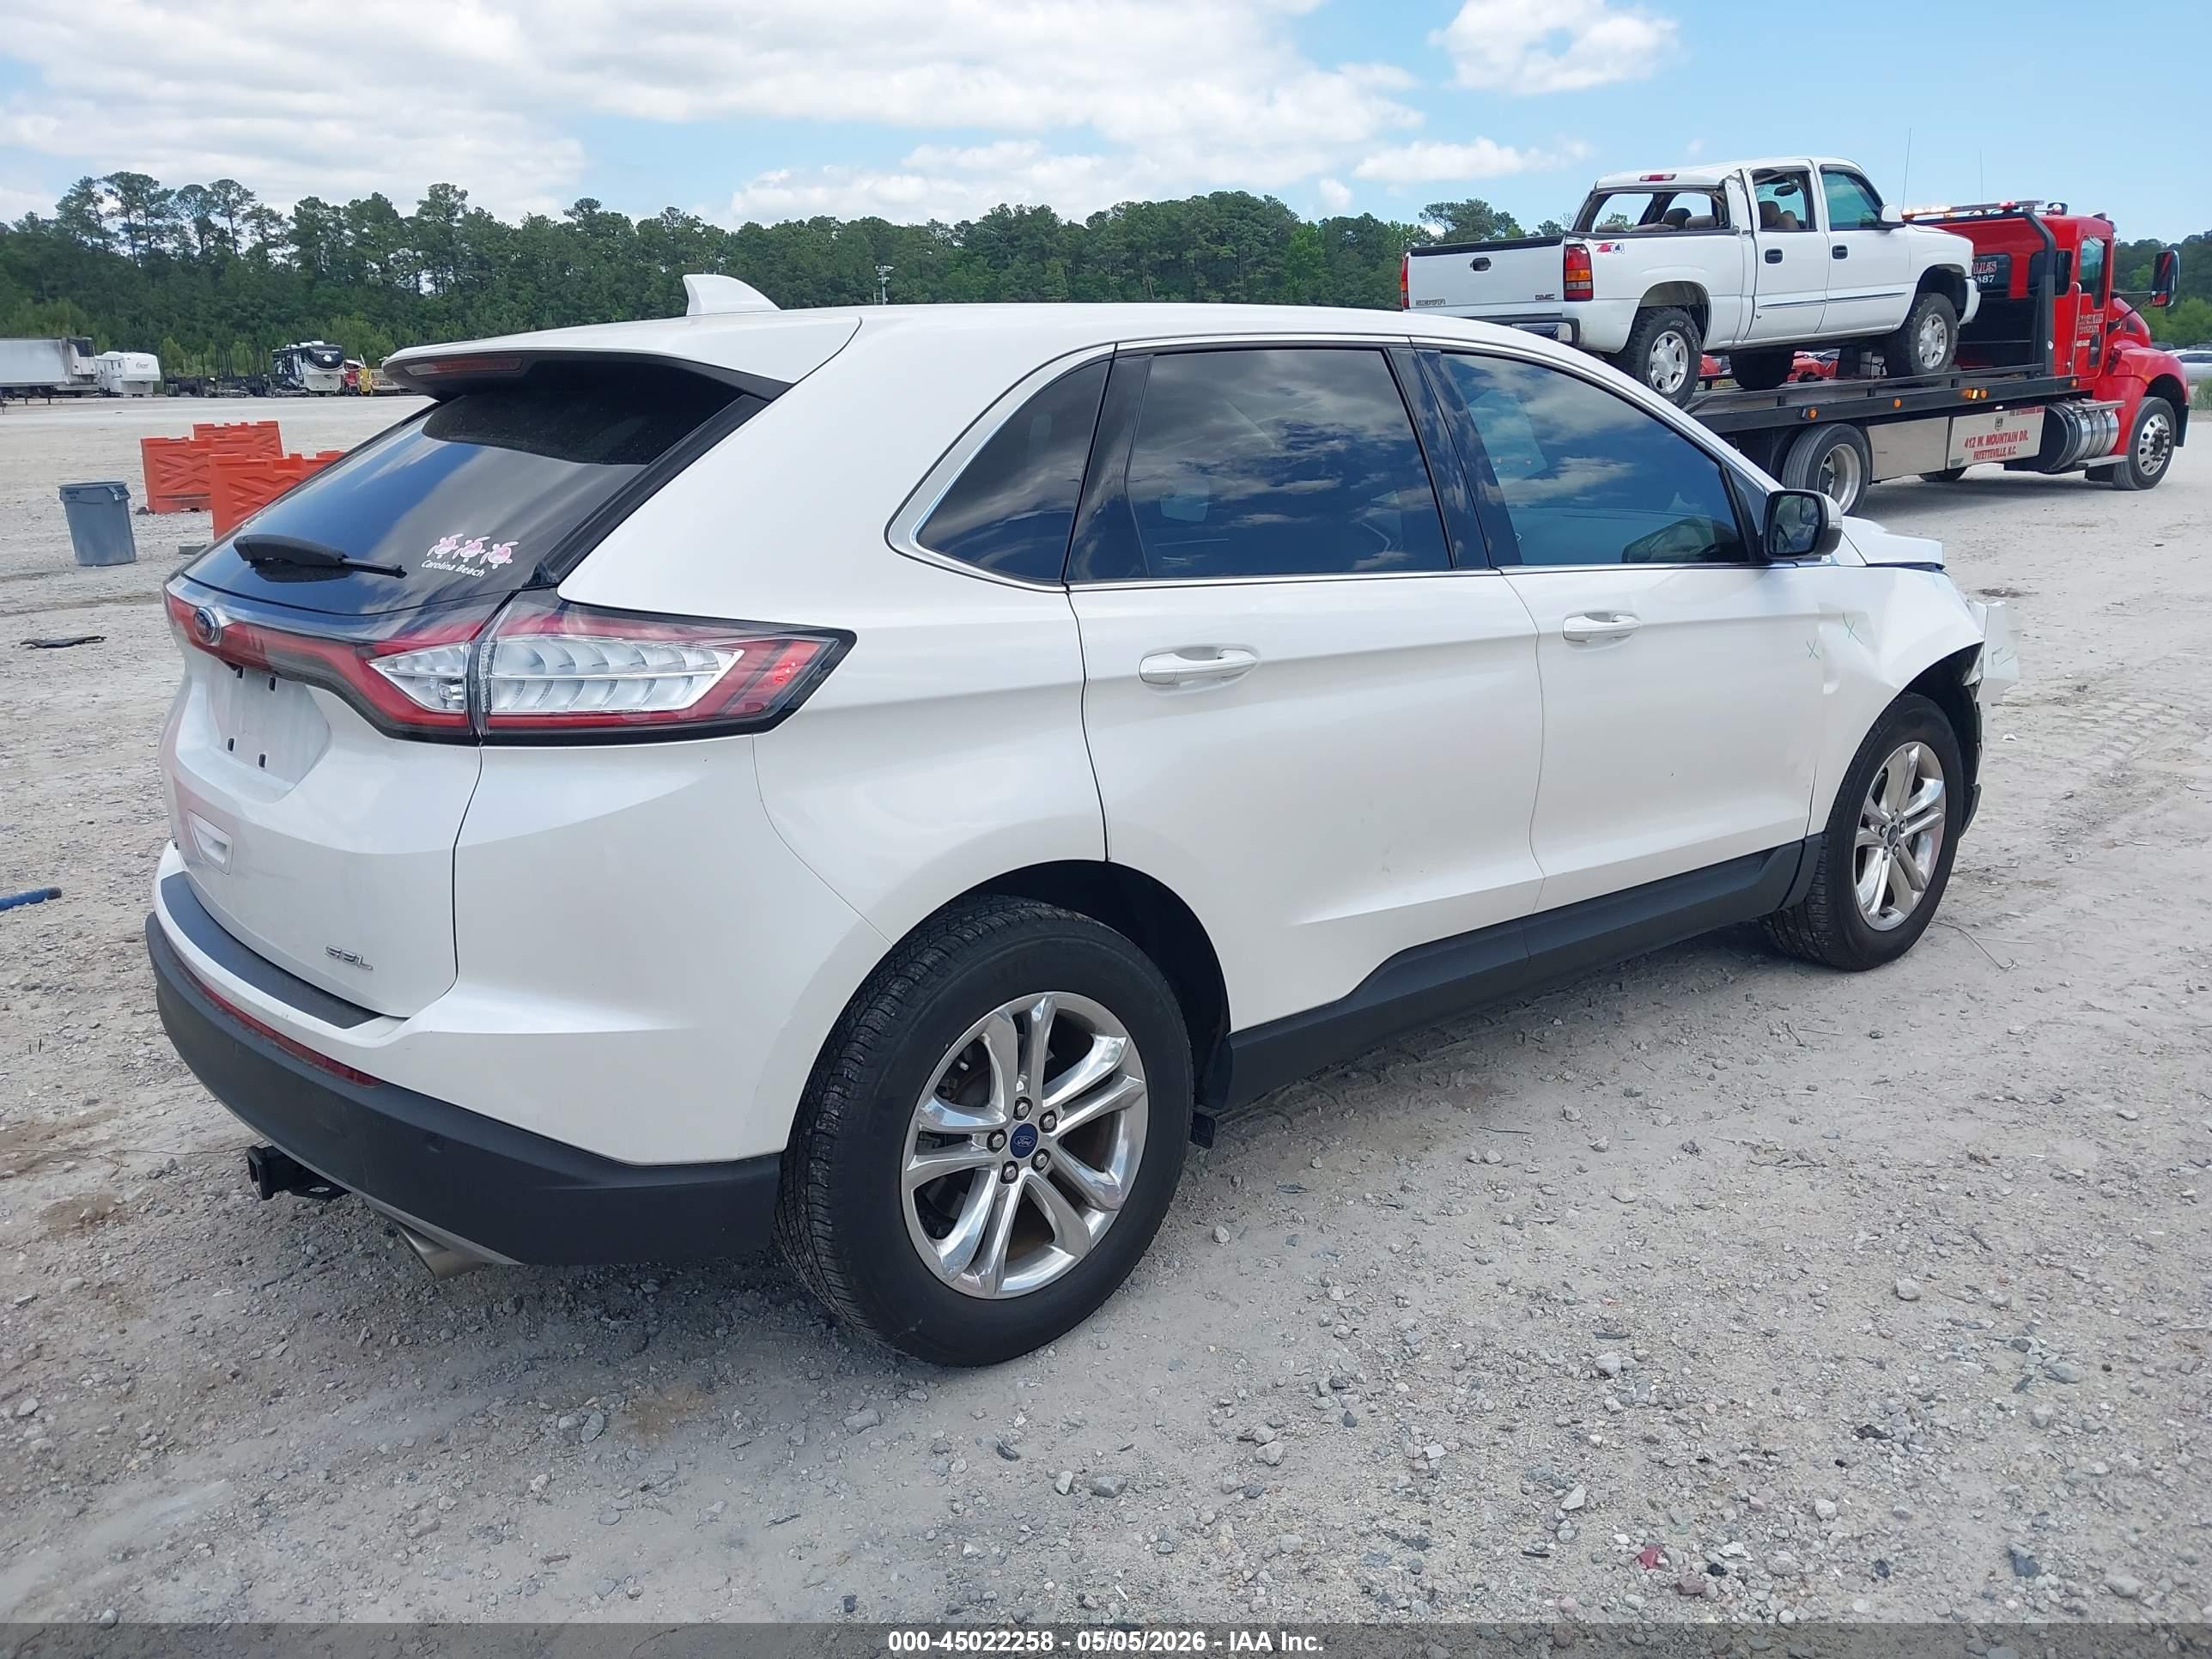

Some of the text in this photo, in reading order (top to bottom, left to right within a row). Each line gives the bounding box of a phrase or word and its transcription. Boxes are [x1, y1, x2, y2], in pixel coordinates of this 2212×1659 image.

[1964, 436, 1976, 449] 412
[1985, 431, 2019, 446] MOUNTAIN
[421, 559, 486, 578] Carolina Beach
[325, 945, 374, 970] SEL
[1016, 1137, 1032, 1146] Ford
